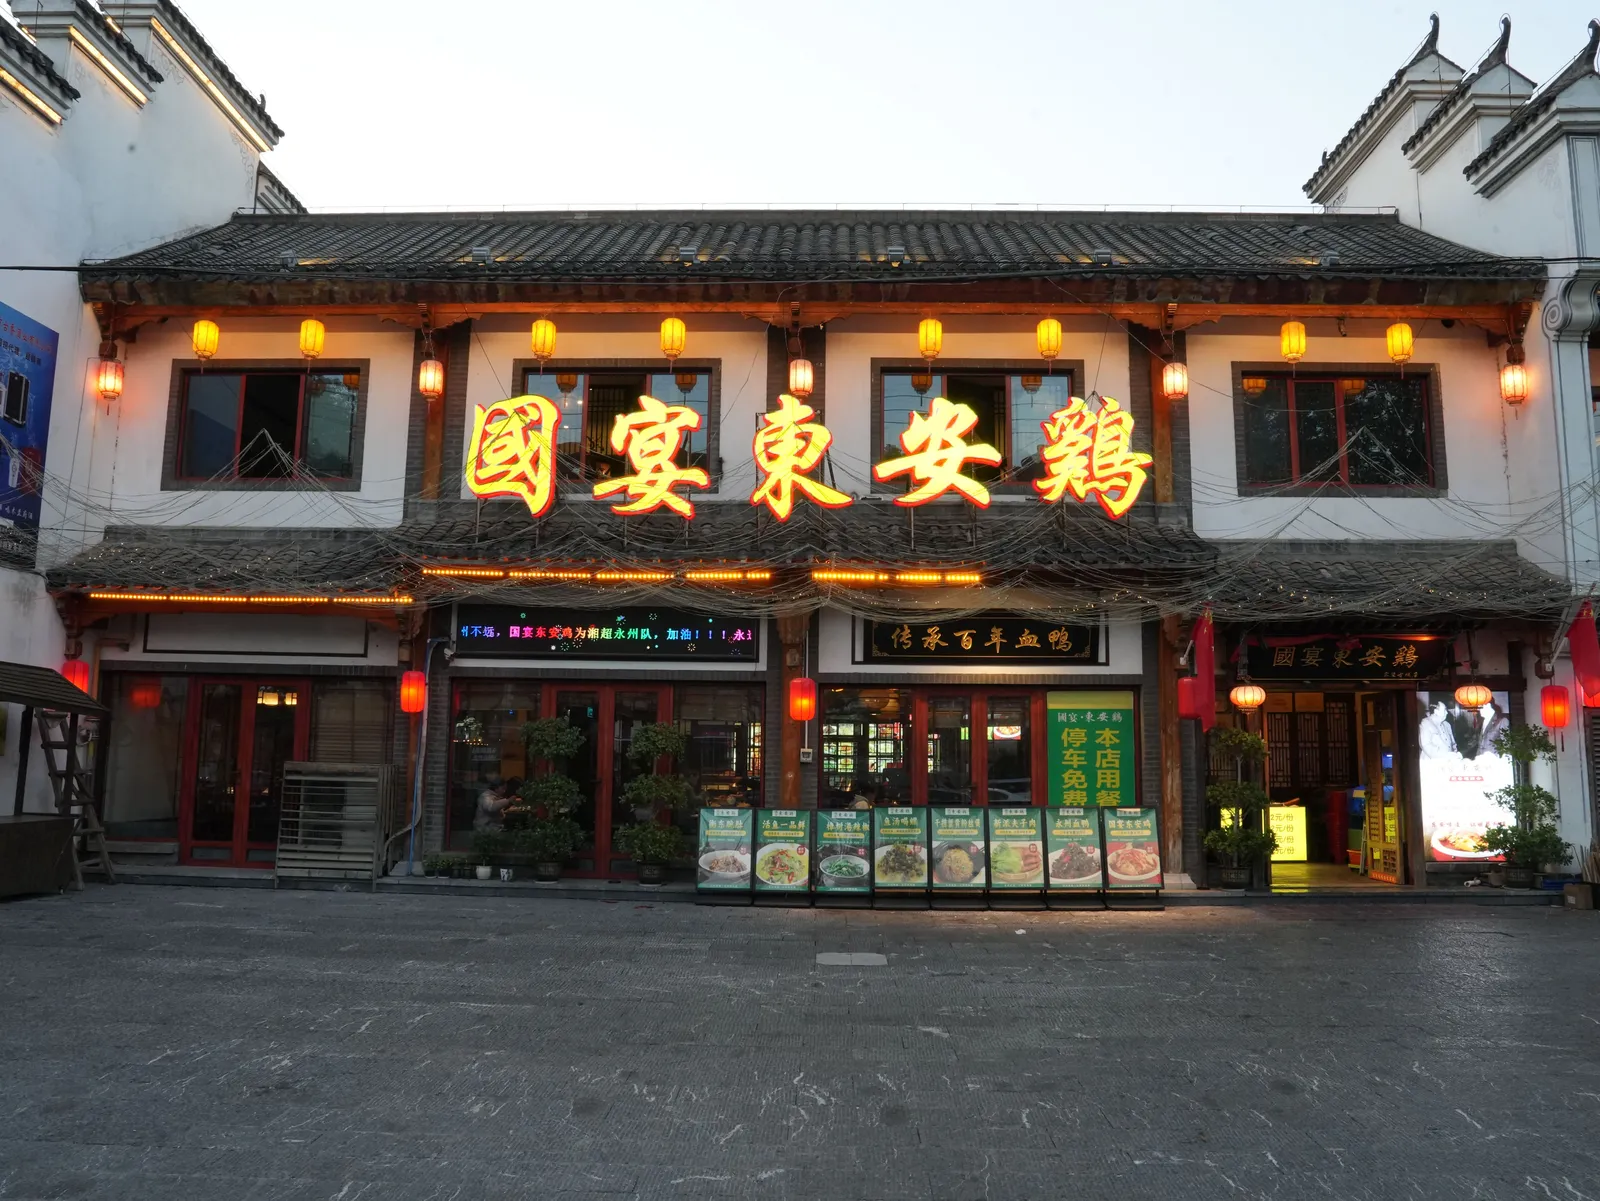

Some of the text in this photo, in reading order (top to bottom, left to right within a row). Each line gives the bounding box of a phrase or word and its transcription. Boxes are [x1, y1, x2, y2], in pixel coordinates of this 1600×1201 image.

[890, 624, 1073, 654] 传承百年血鸭
[1061, 727, 1088, 806] 停车免费
[1095, 727, 1121, 806] 本店用餐
